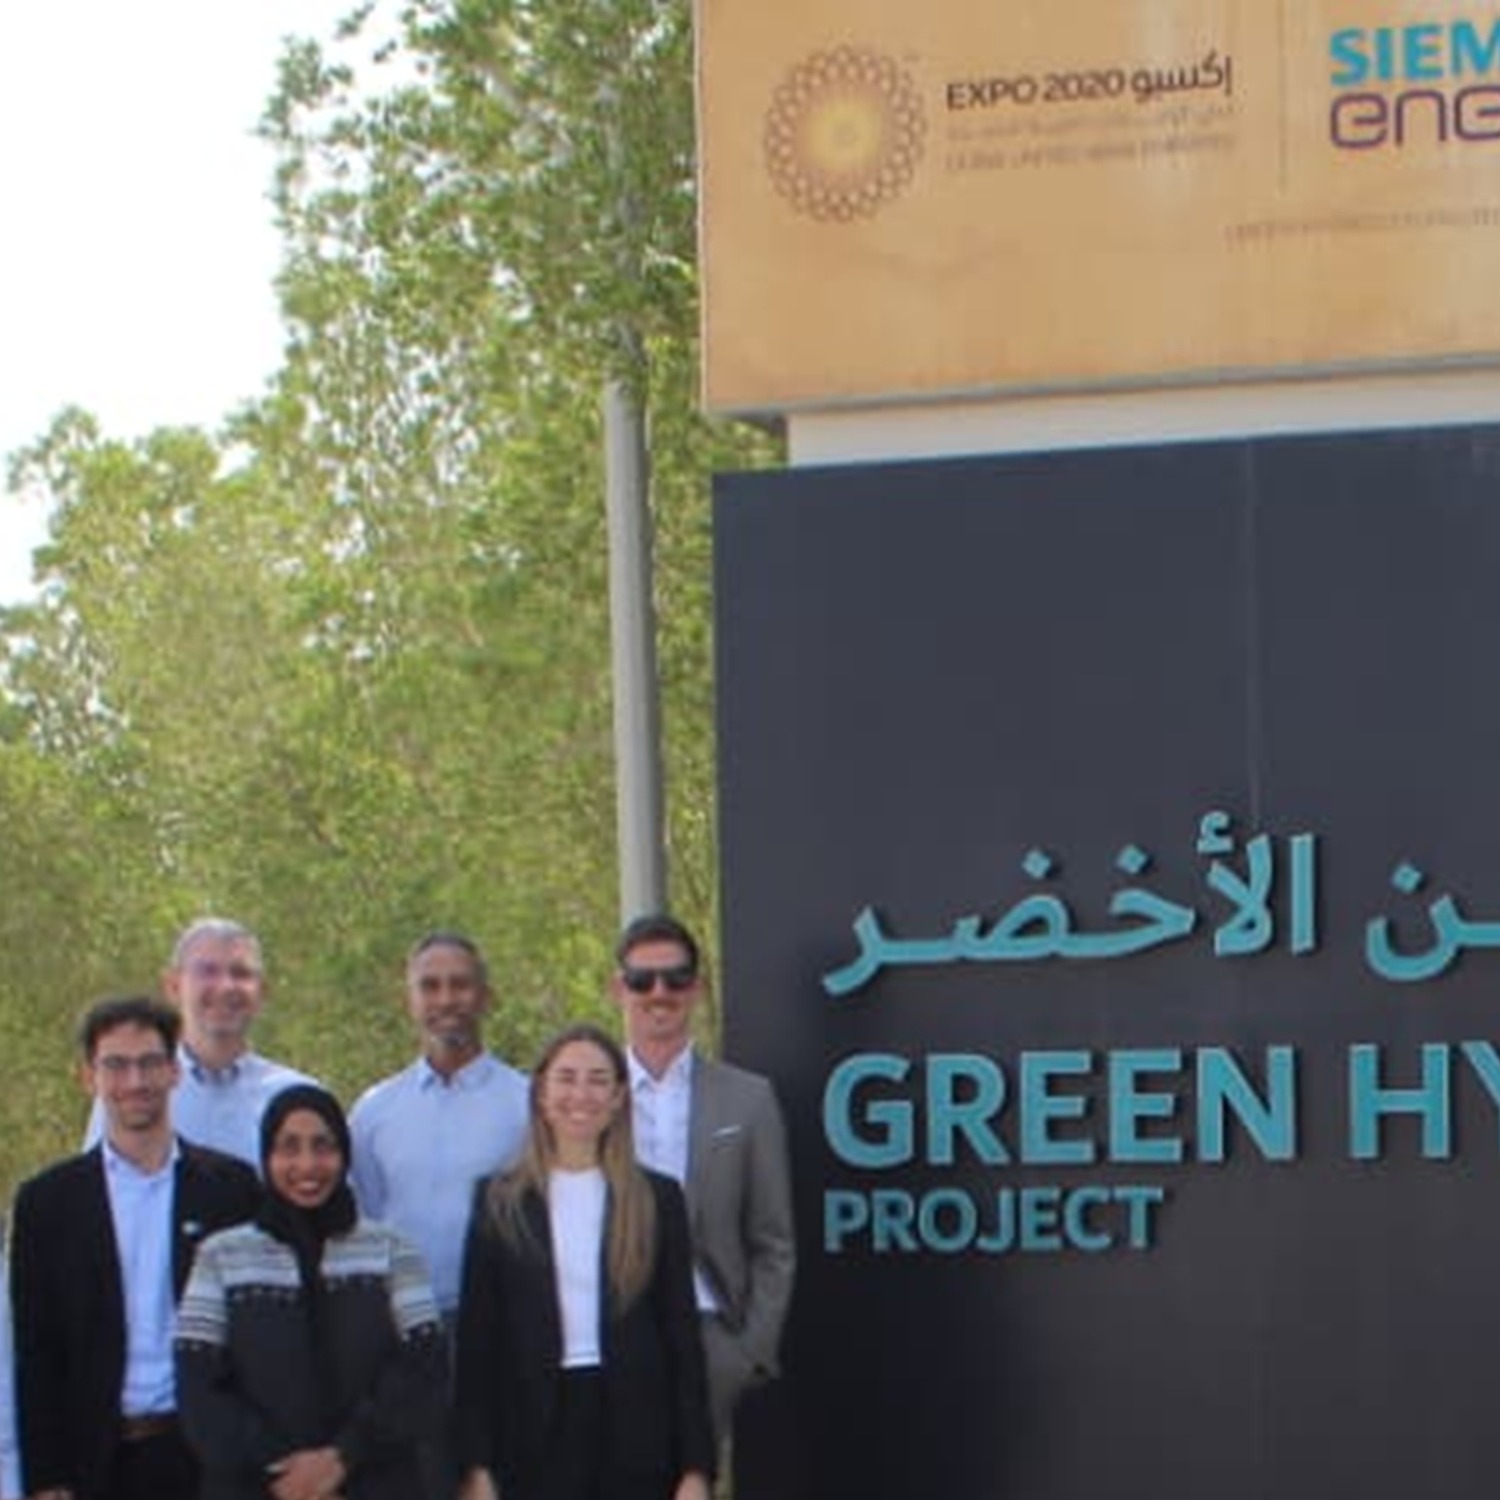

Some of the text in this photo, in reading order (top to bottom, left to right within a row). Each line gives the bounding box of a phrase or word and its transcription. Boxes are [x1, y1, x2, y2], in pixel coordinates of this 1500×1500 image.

[946, 69, 1126, 111] EXPO 2020
[822, 810, 1316, 995] الأخضر
[822, 1044, 1296, 1169] GREEN
[822, 1187, 1165, 1253] PROJECT
